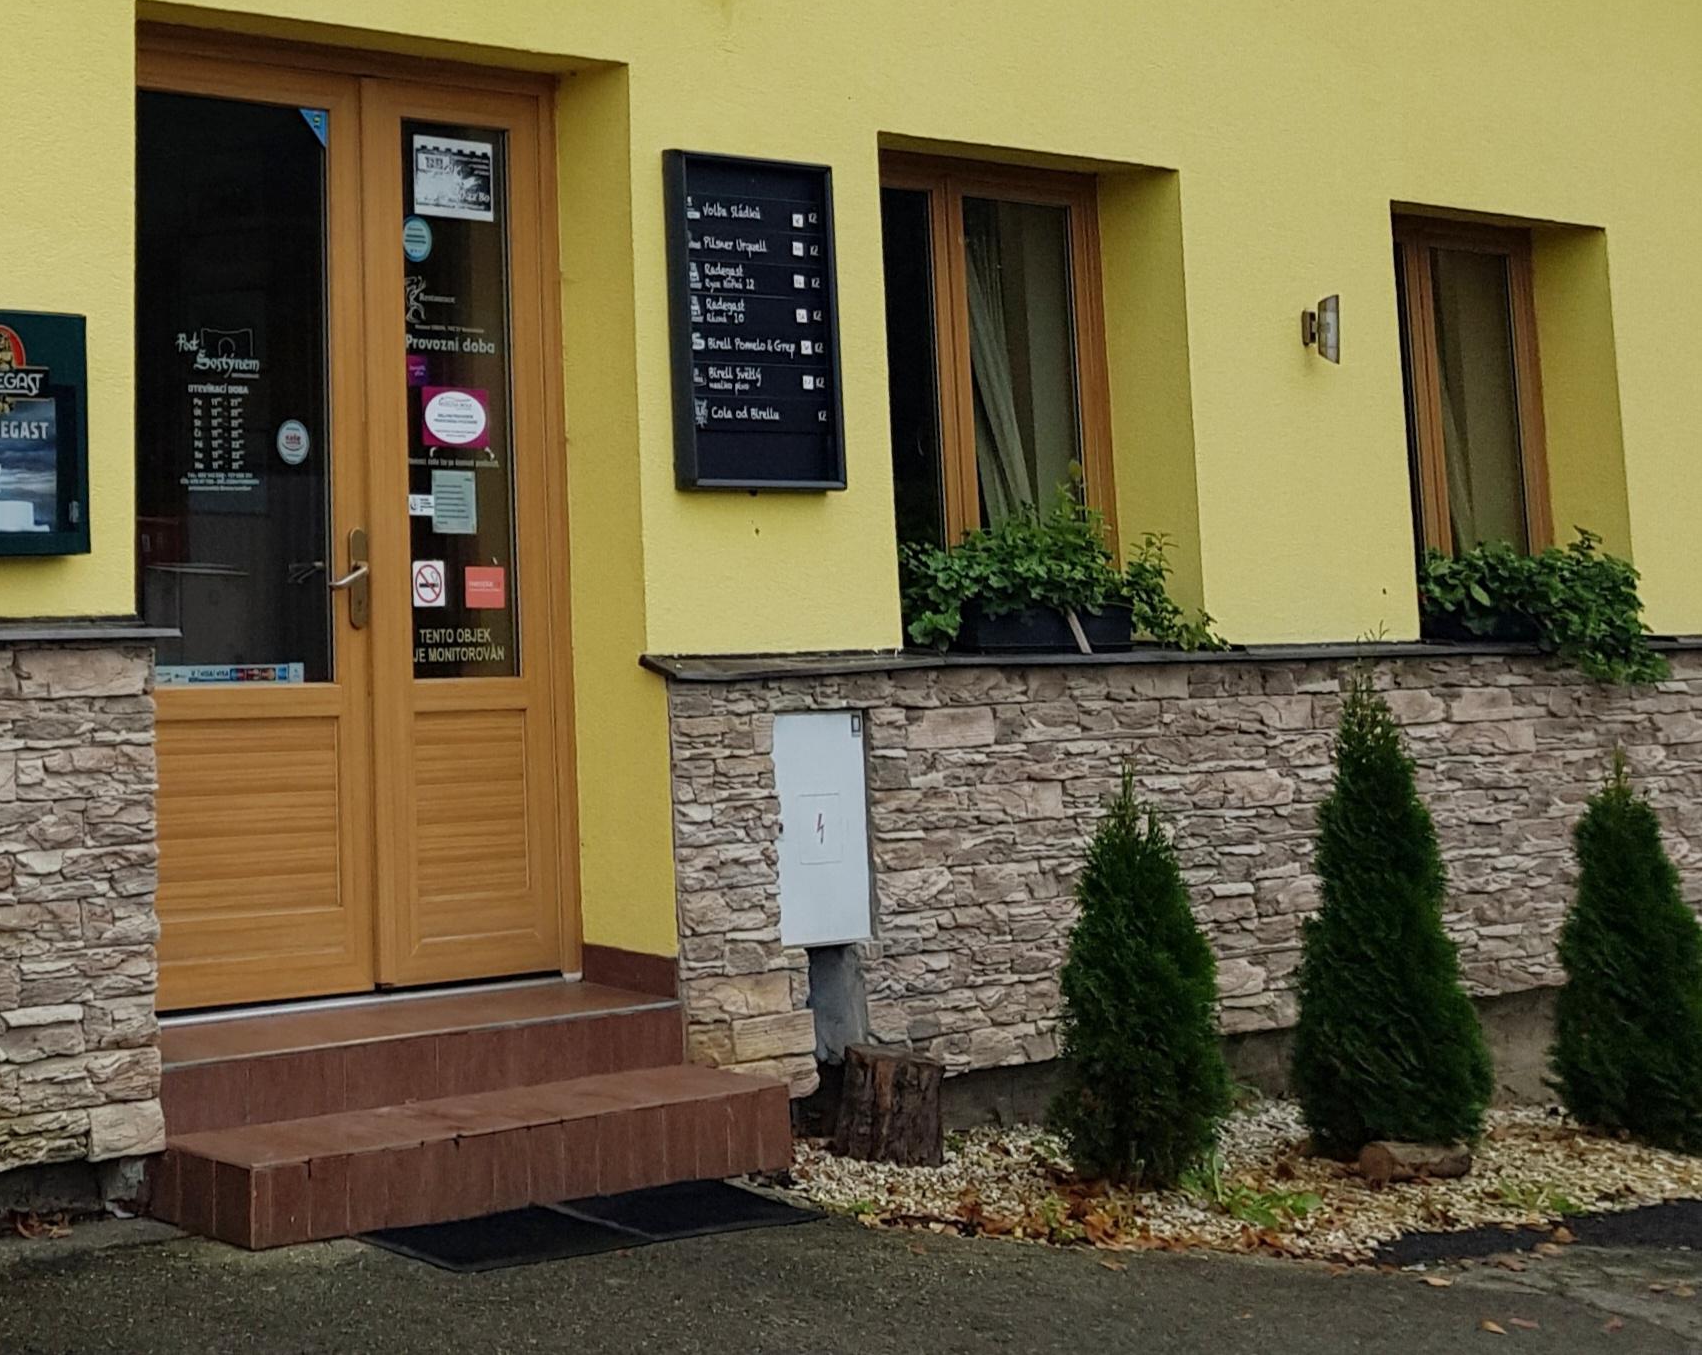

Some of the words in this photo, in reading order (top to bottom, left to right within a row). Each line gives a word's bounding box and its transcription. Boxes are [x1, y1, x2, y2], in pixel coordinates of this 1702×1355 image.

[702, 201, 727, 218] Volba
[808, 212, 817, 224] Kč
[703, 235, 734, 251] Pilsner
[735, 237, 768, 259] Urquell
[810, 245, 819, 256] Kč
[704, 261, 744, 279] Radegast
[745, 277, 755, 290] 12
[811, 277, 820, 288] Kč
[706, 296, 745, 315] Radegast
[734, 312, 745, 324] 10
[813, 310, 822, 321] Kč
[175, 331, 200, 353] Pod
[462, 337, 496, 354] doba
[707, 337, 732, 350] Birell
[735, 337, 766, 351] Pomelo
[774, 339, 796, 359] Grep
[815, 342, 824, 353] Kč
[193, 349, 260, 379] Šostýnem
[708, 366, 733, 380] Birell
[816, 377, 825, 388] Kč
[711, 406, 733, 419] Cola
[736, 405, 748, 419] od
[818, 410, 827, 422] Kč
[419, 628, 454, 644] TENTO
[456, 628, 492, 643] OBJEK
[413, 647, 426, 663] JE
